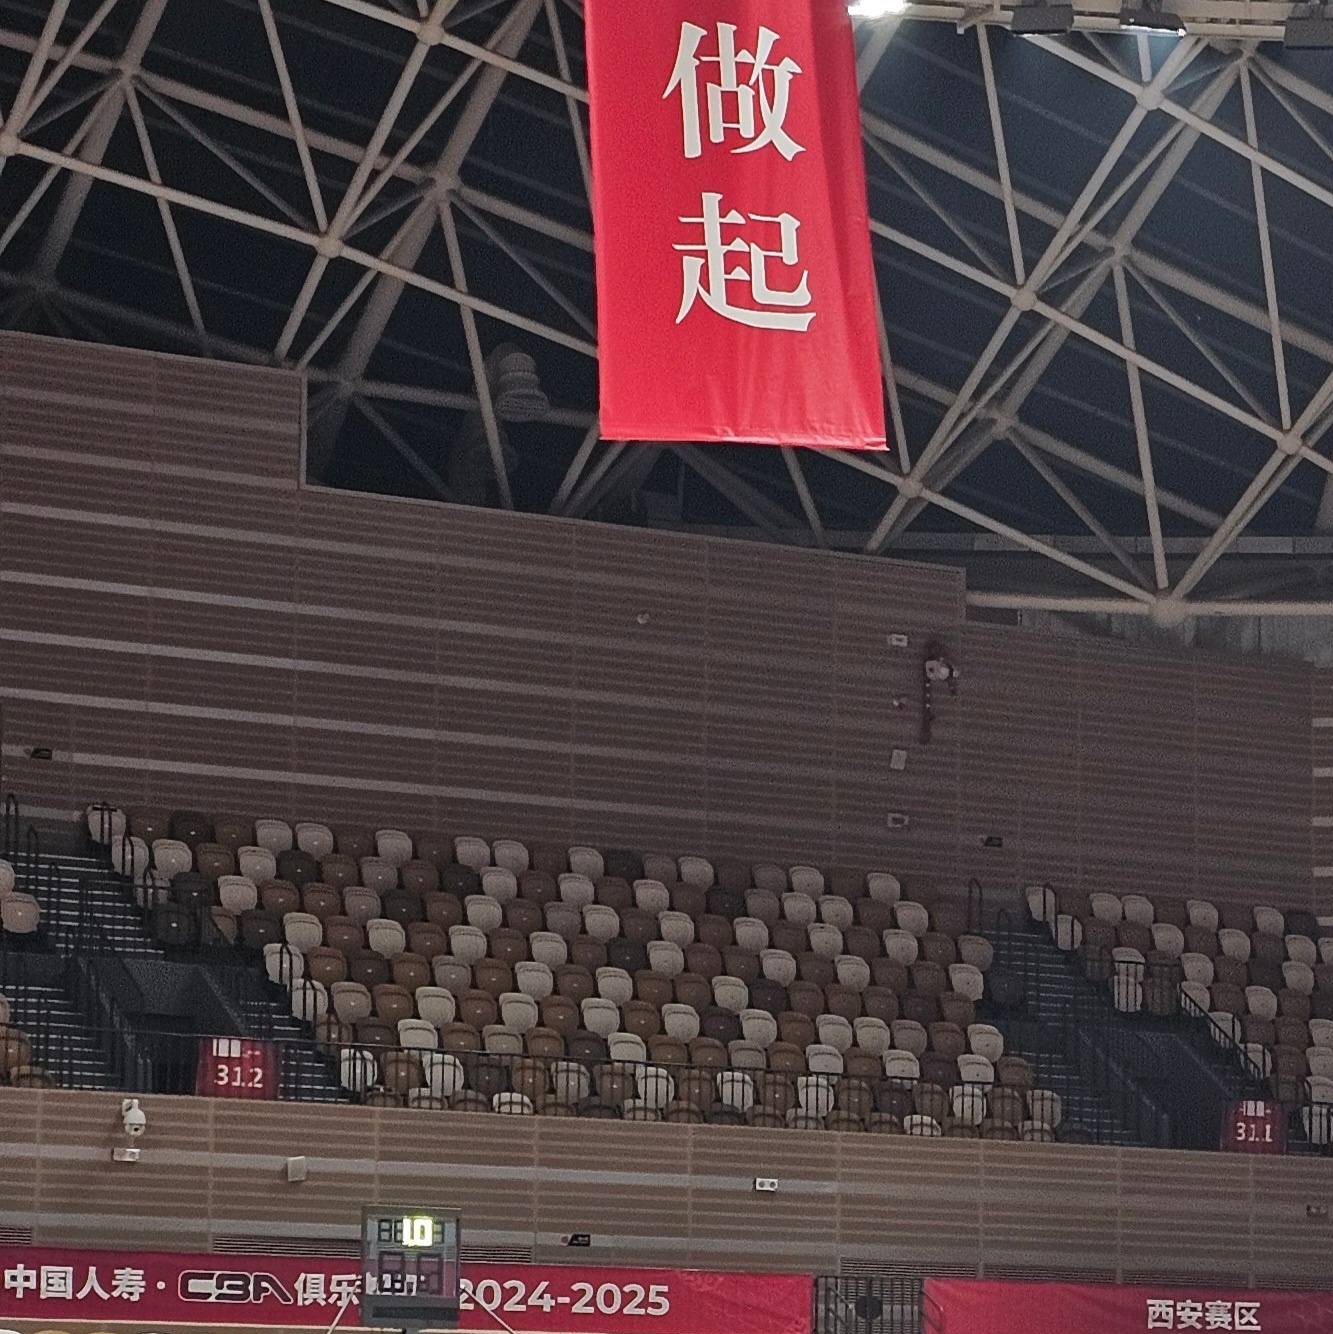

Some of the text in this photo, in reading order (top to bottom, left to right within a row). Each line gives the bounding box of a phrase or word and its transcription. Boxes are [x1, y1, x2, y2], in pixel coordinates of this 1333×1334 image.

[663, 22, 816, 331] 做起
[1146, 1298, 1261, 1332] 西安赛区
